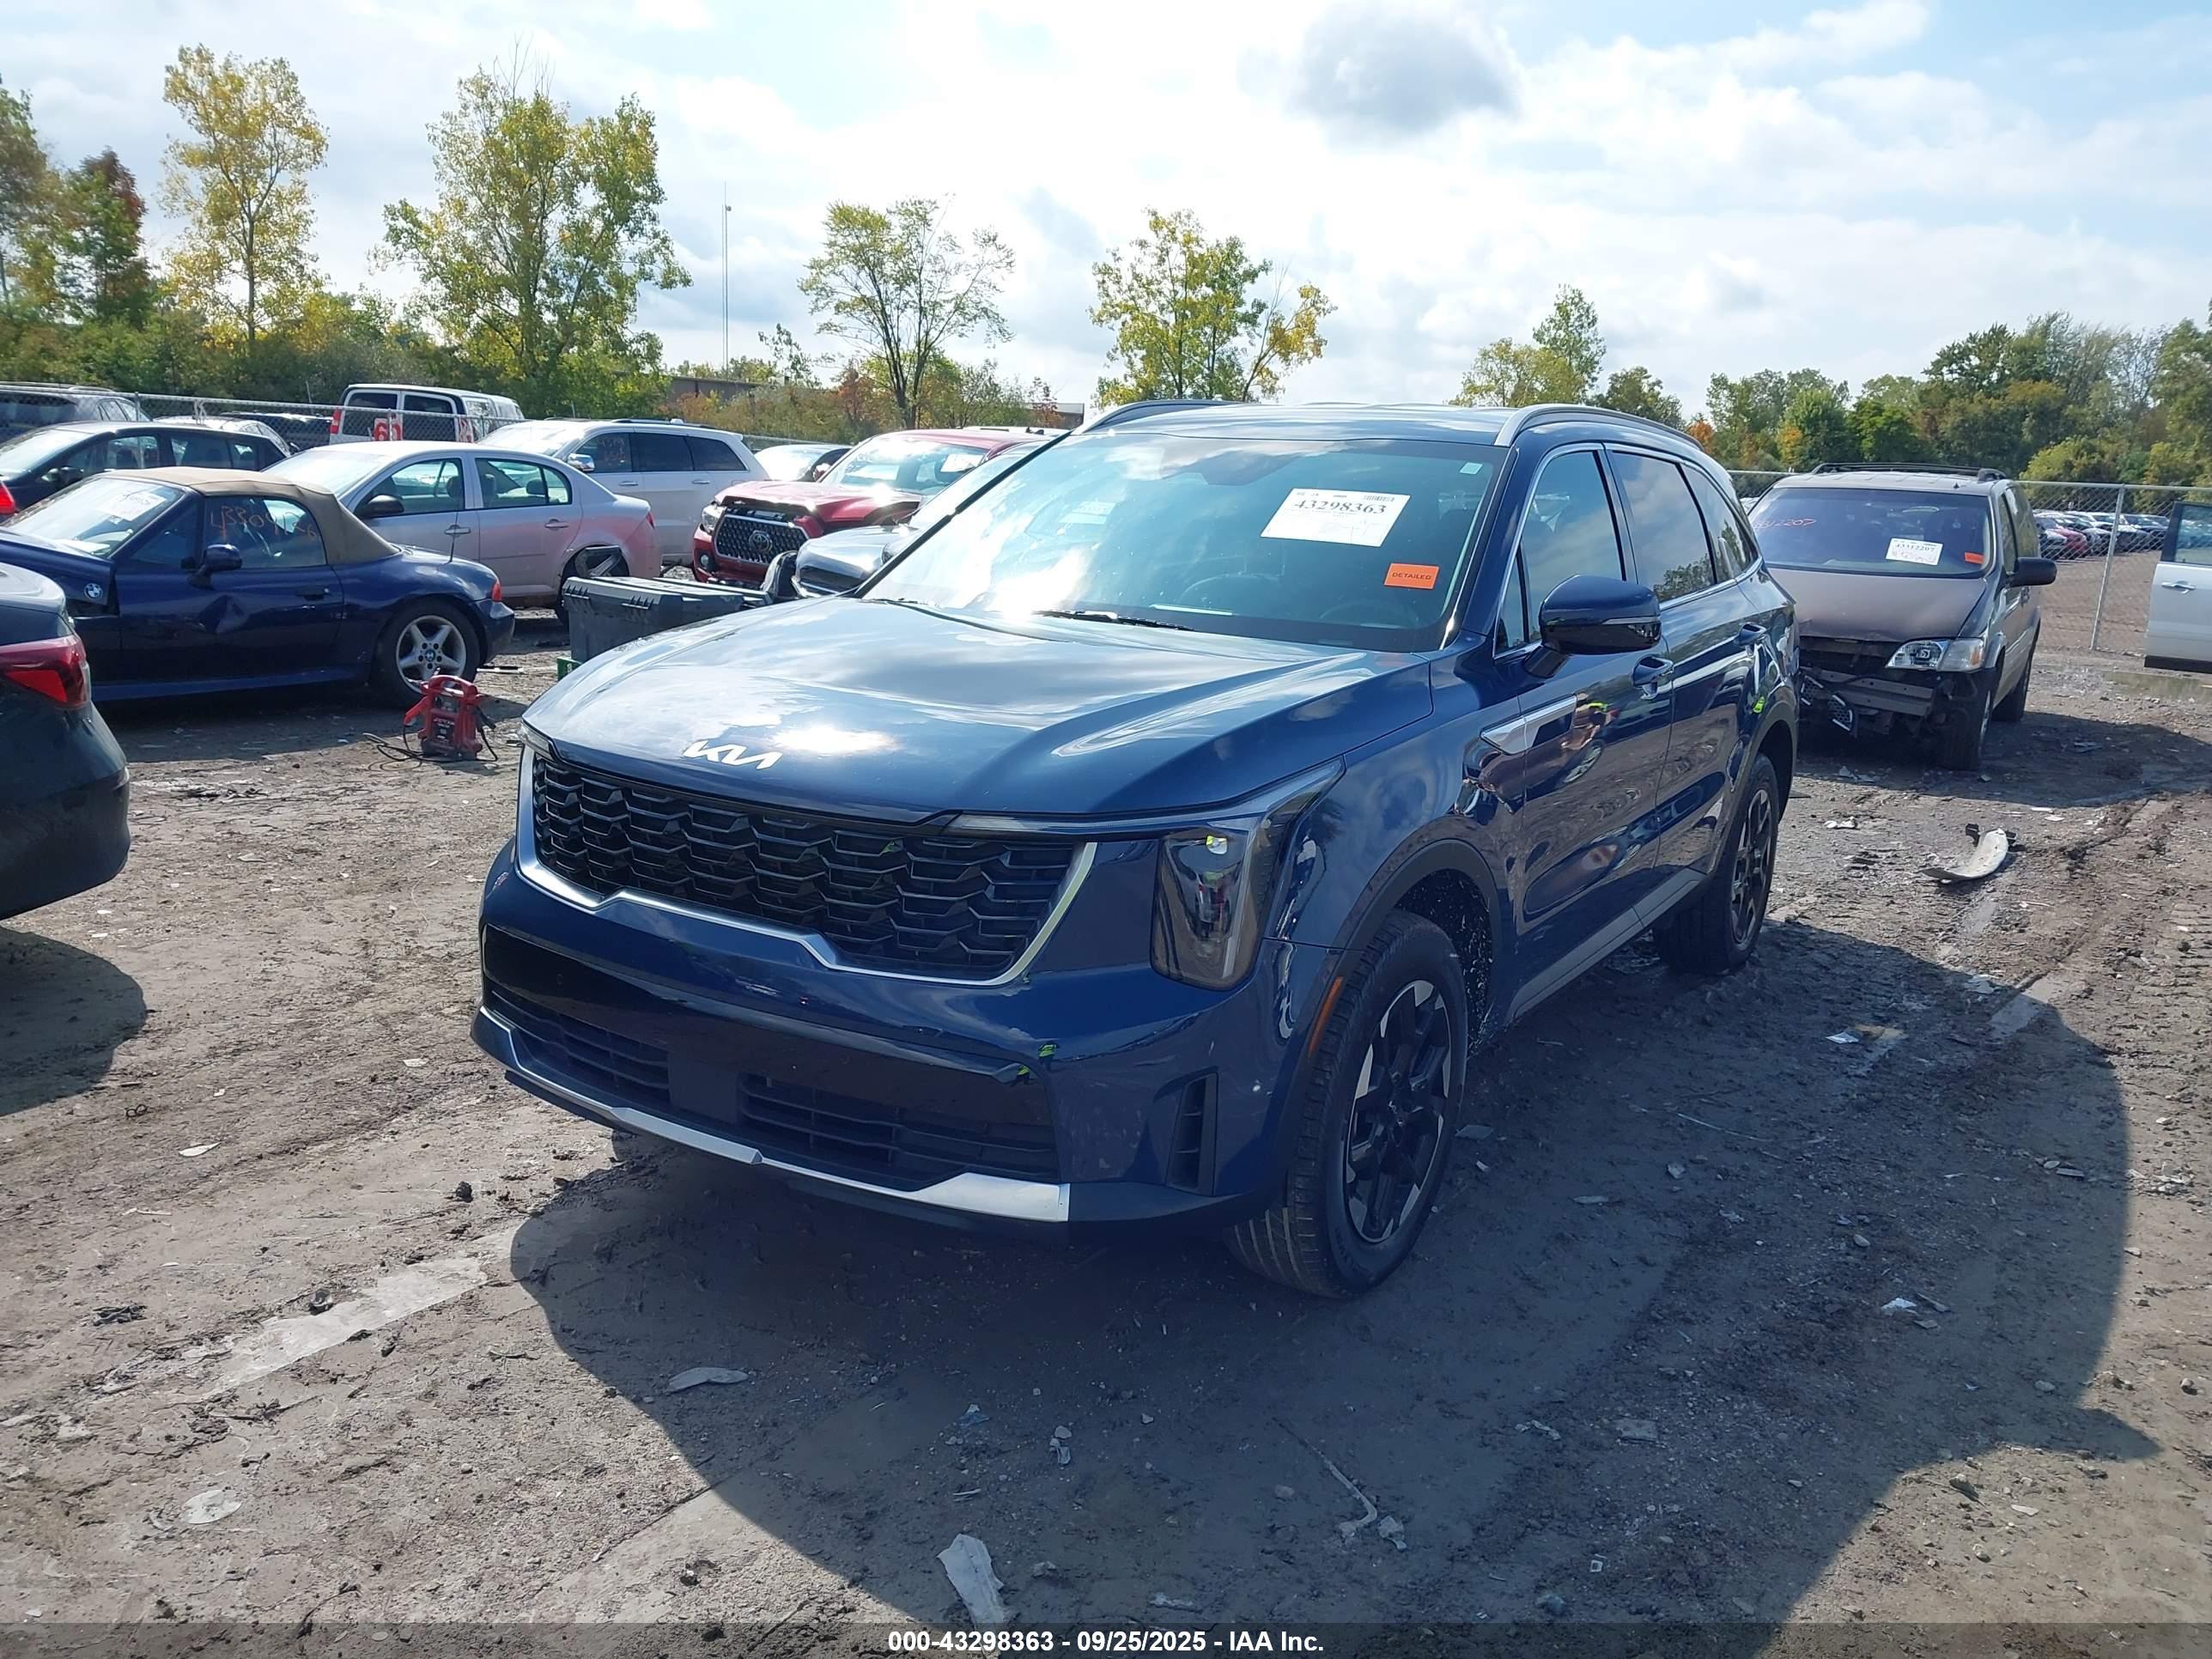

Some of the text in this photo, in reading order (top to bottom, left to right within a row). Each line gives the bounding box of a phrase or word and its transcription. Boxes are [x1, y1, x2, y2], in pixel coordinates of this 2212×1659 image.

[1293, 500, 1387, 514] 43298363
[1392, 572, 1431, 580] DETAILED
[683, 739, 782, 770] KIA
